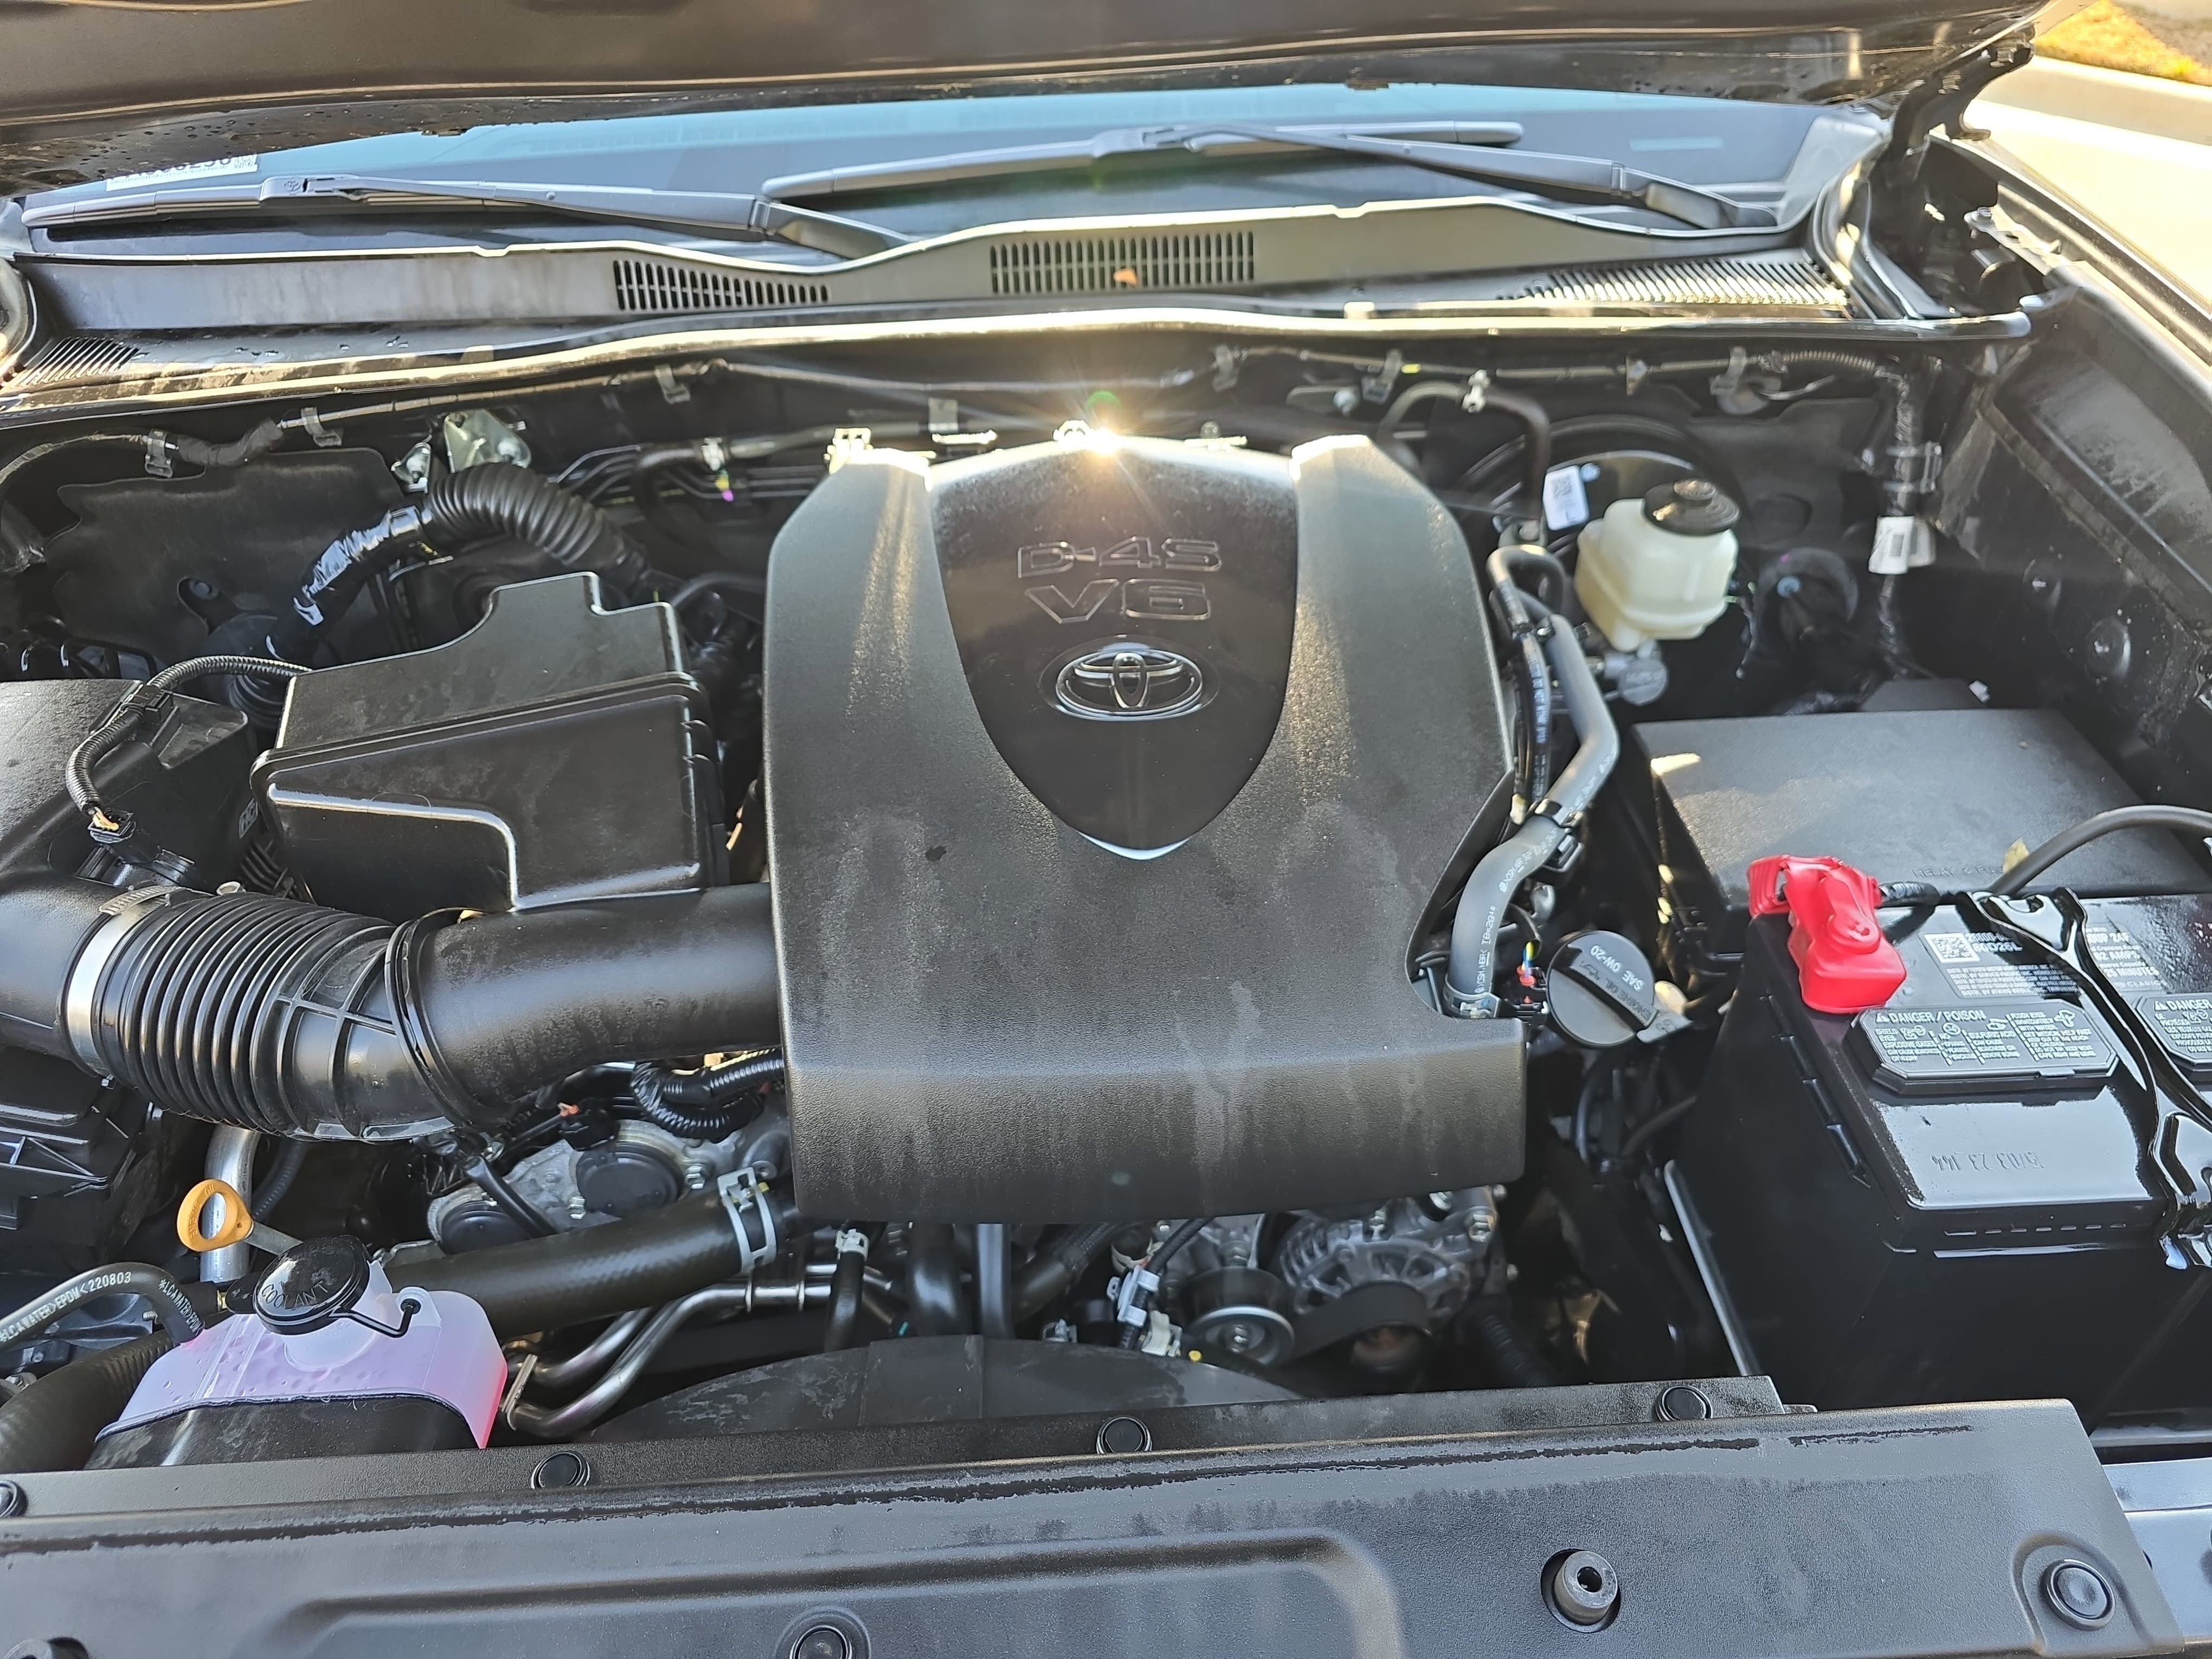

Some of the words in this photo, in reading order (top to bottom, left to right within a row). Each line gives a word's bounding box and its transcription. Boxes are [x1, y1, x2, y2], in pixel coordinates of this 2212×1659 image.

[1024, 578, 1212, 625] V6
[1590, 944, 1623, 975] 0W-20
[1622, 970, 1644, 991] SAE
[260, 1280, 329, 1311] COOLANT
